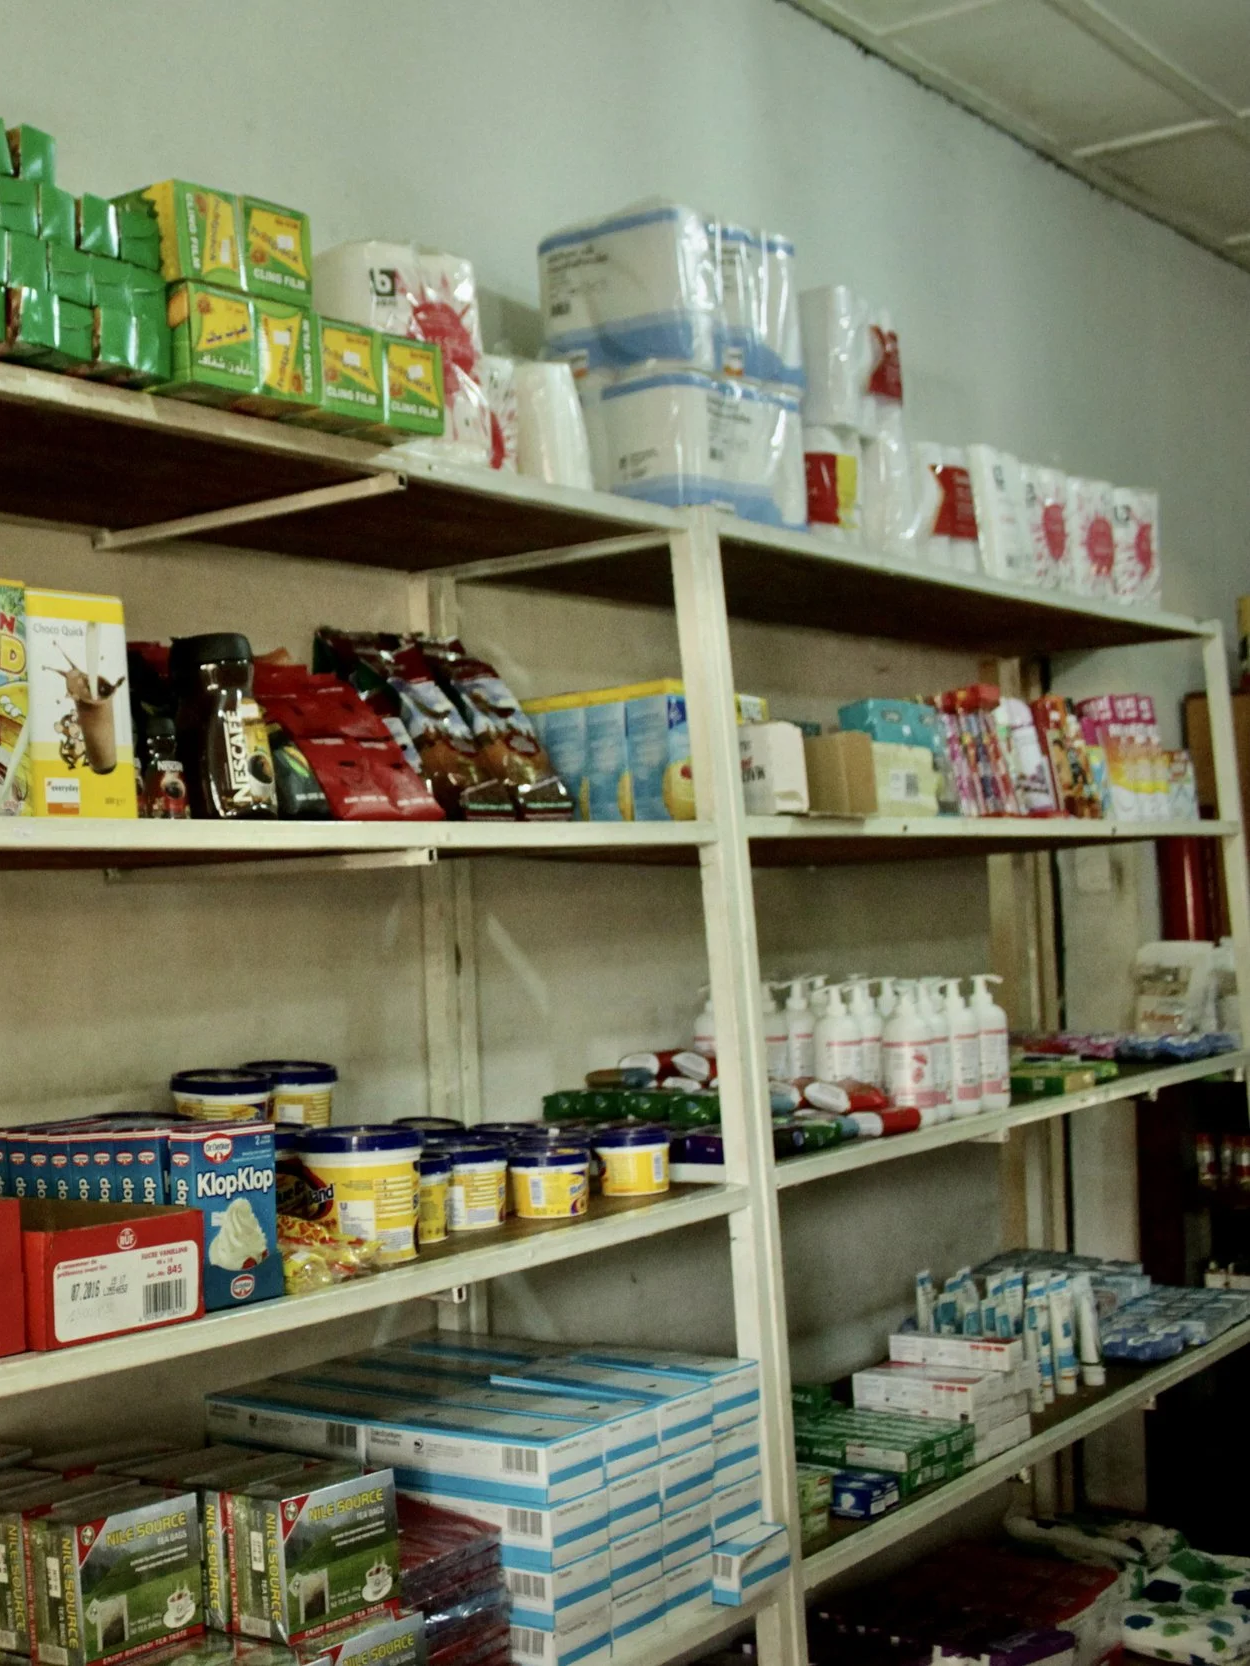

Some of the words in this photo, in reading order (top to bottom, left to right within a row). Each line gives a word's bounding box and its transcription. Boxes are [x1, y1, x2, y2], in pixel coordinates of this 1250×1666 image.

[283, 275, 306, 290] FILM
[33, 623, 59, 636] Choco
[62, 625, 84, 637] Quick
[166, 1264, 183, 1276] 845
[206, 1504, 217, 1538] NILE
[308, 1504, 335, 1522] NILE
[337, 1488, 384, 1514] SOURCE
[106, 1526, 134, 1547] NILE
[136, 1512, 187, 1538] SOURCE
[266, 1512, 279, 1549] NILE
[62, 1537, 74, 1574] NILE
[207, 1543, 220, 1610] SOURCE
[268, 1553, 282, 1620] SOURCE
[64, 1579, 79, 1649] SOURCE
[369, 1632, 415, 1661] SOURCE
